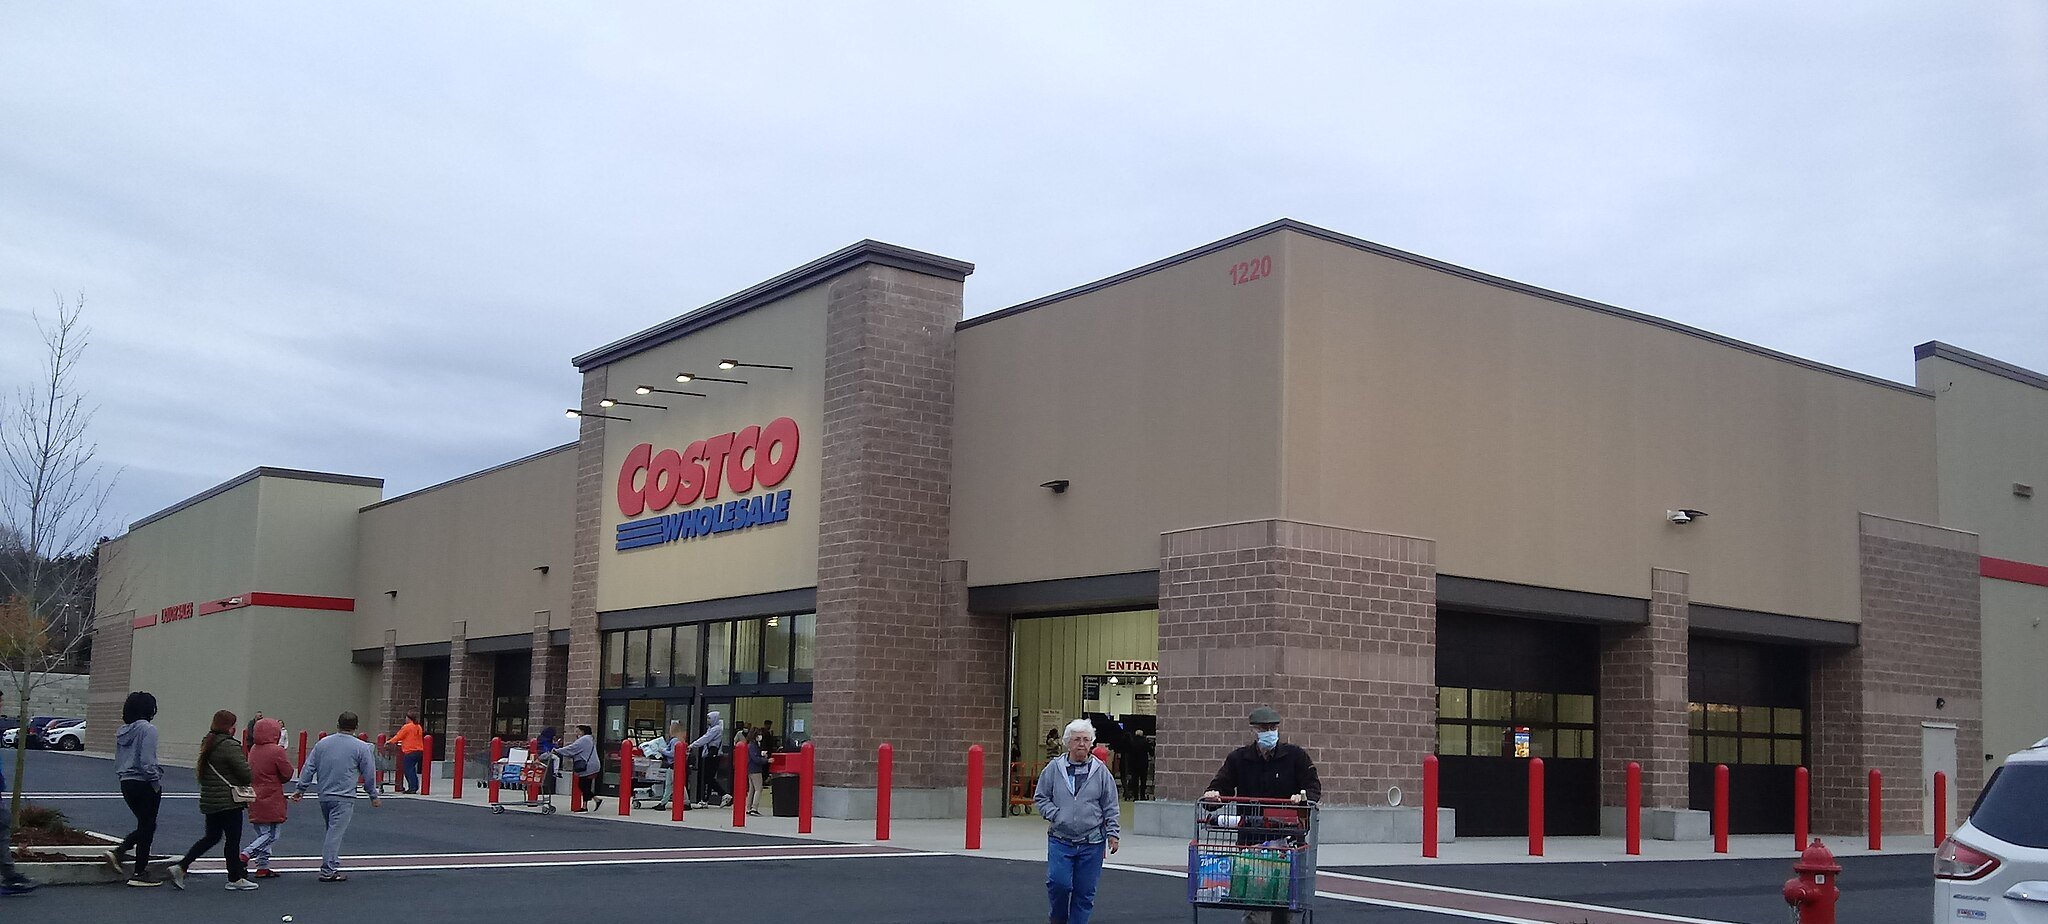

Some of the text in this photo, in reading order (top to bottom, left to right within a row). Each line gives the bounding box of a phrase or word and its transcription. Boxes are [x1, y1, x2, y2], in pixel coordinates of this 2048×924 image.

[1230, 256, 1272, 286] 1220
[617, 417, 799, 517] COSTCO
[661, 489, 792, 543] WHOLESALE
